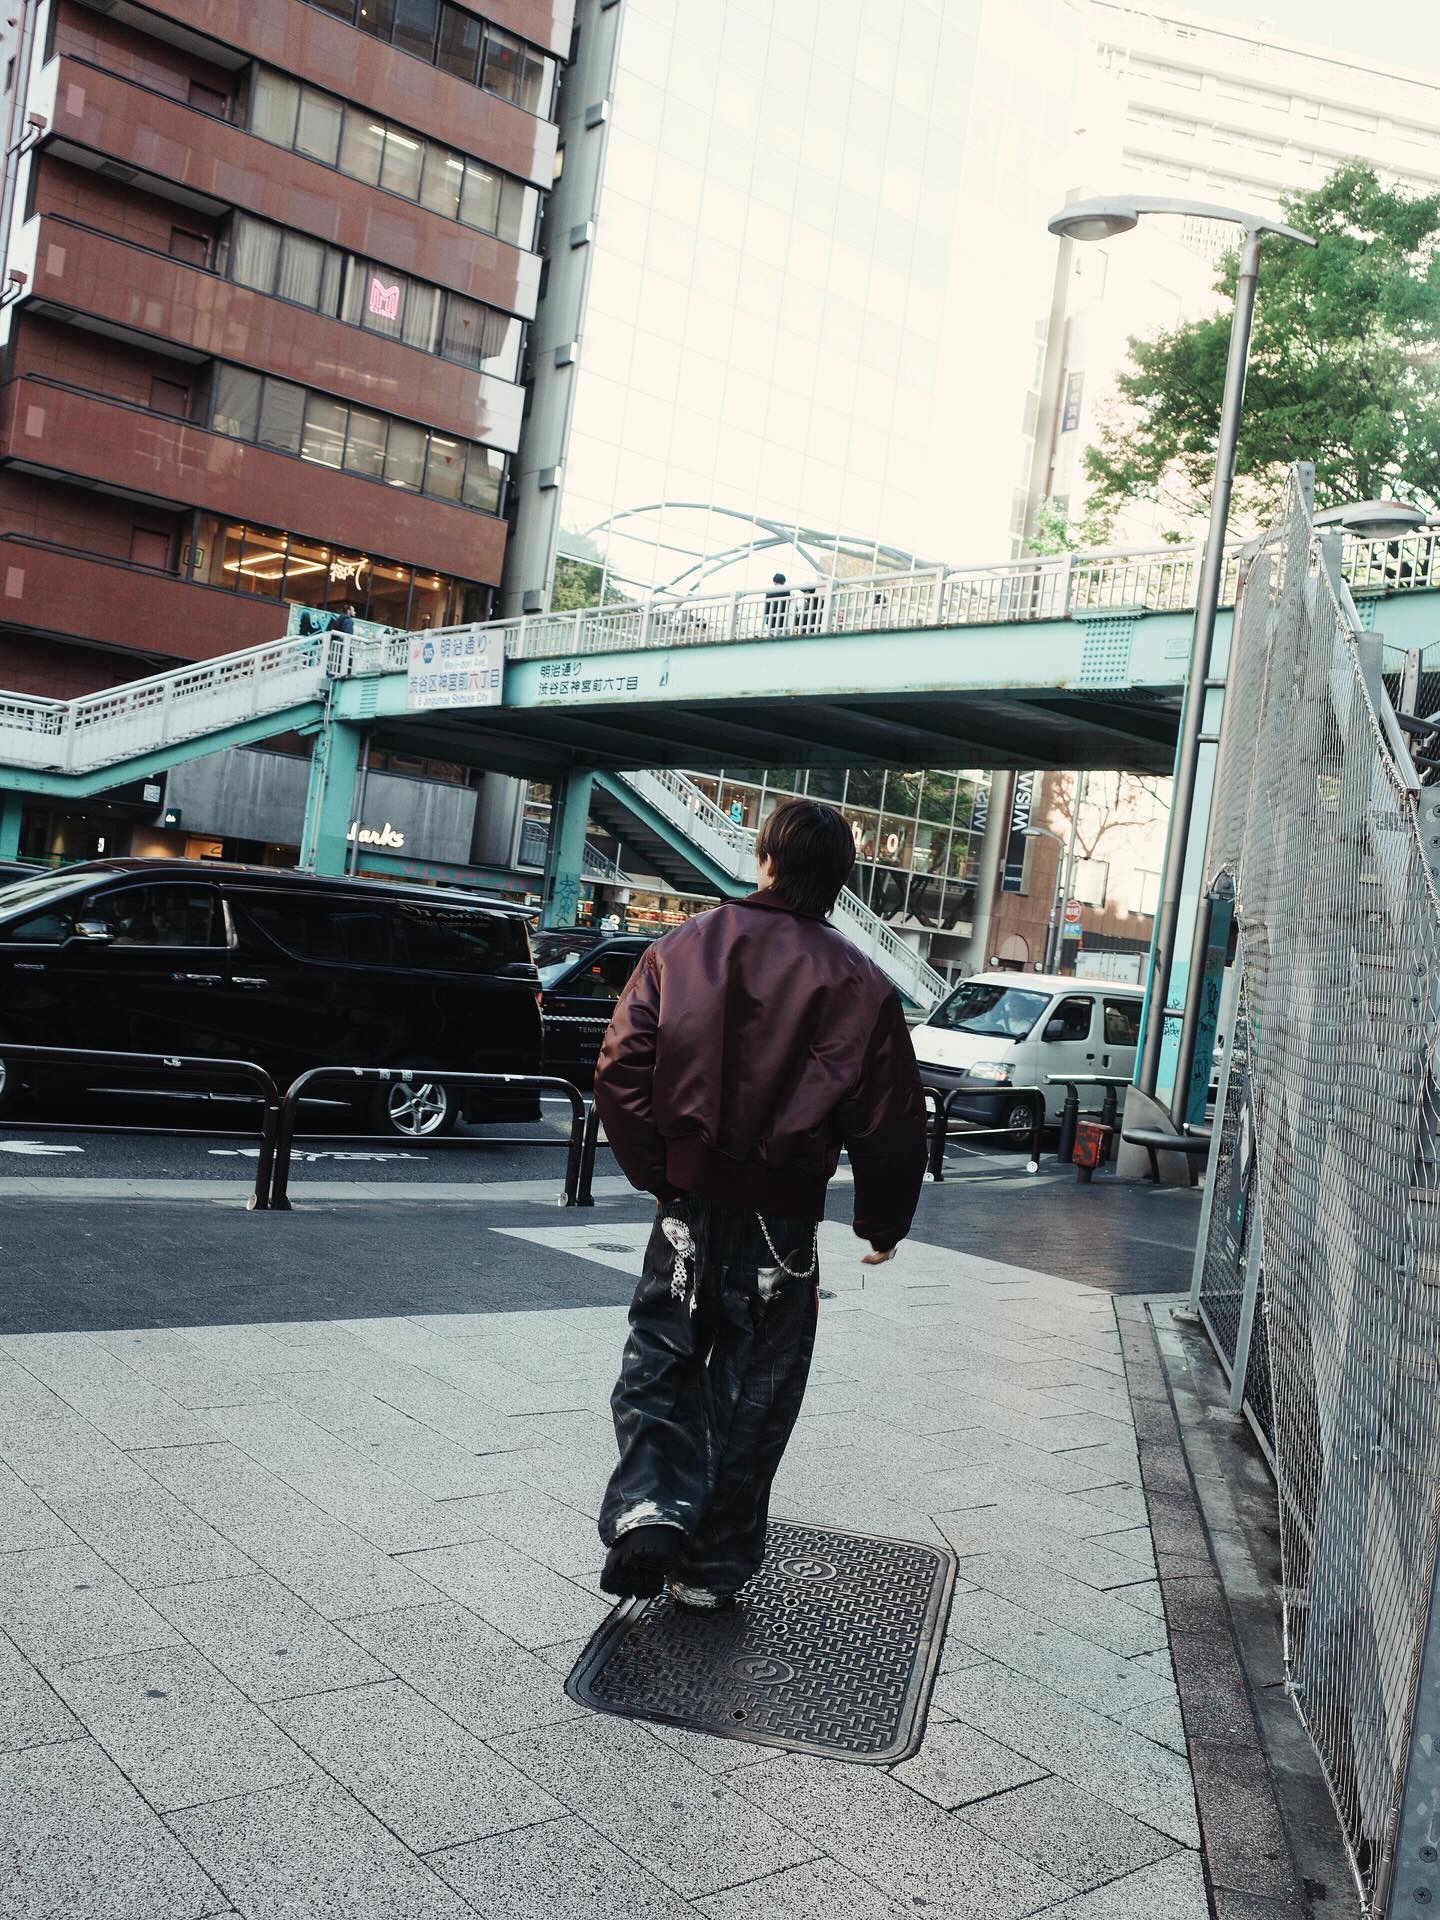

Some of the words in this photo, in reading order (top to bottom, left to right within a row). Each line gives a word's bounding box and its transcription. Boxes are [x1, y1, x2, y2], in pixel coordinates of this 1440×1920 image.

[441, 635, 487, 656] 明治通り
[410, 668, 500, 693] 渋谷区神宮前六丁目
[540, 662, 582, 678] 明治通り
[538, 676, 638, 696] 渋谷区神宮前六丁目
[346, 821, 405, 848] larks
